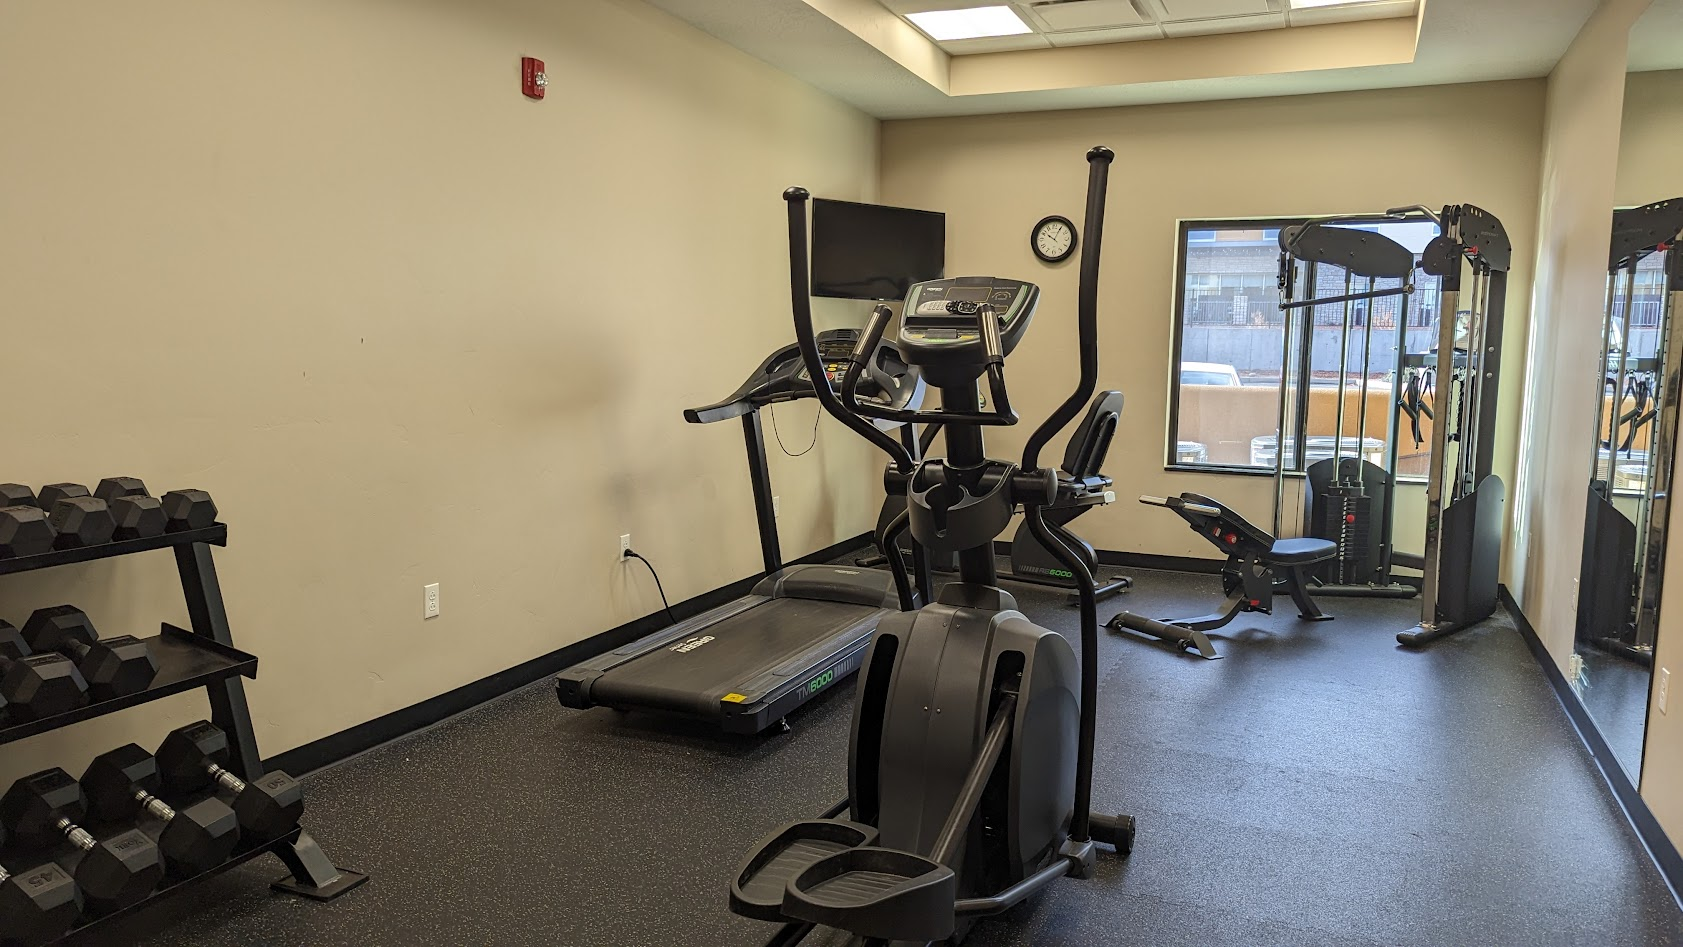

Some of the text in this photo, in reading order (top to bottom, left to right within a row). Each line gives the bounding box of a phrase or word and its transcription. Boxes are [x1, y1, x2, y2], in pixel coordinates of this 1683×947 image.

[796, 670, 833, 700] TM6000
[266, 778, 286, 790] 50
[28, 872, 52, 888] 45
